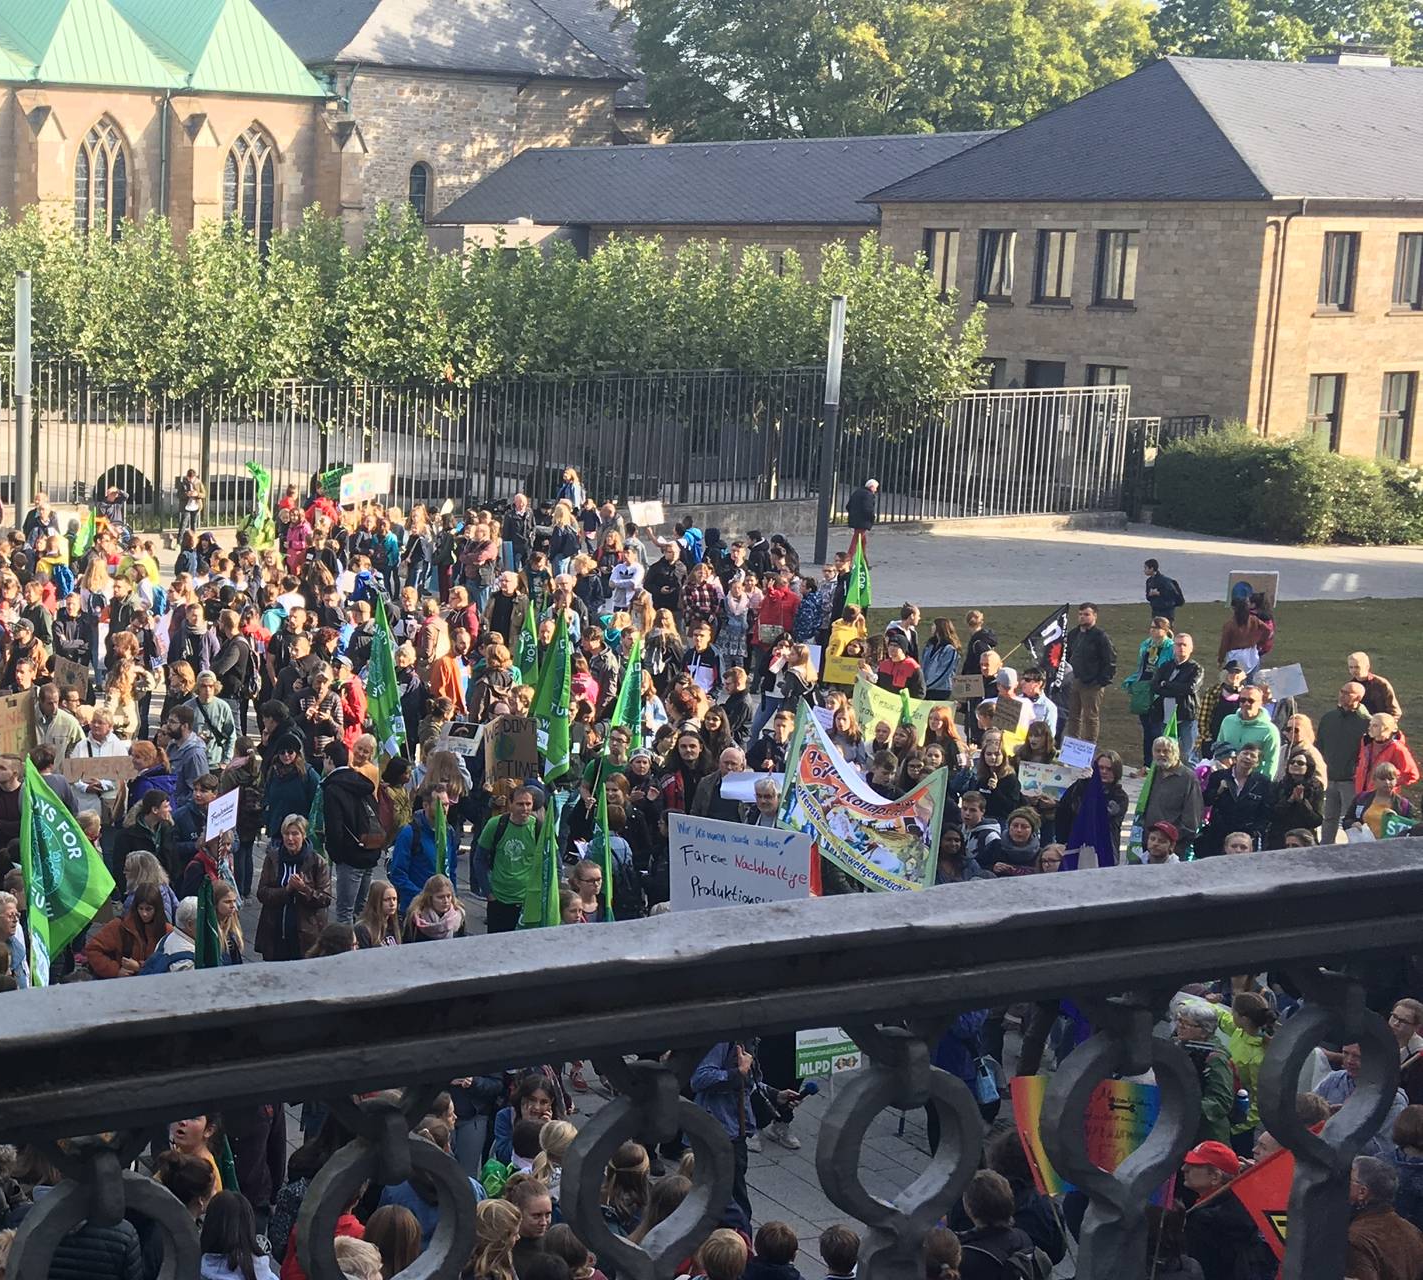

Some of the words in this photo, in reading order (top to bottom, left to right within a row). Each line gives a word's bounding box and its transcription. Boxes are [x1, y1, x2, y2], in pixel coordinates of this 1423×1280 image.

[507, 759, 538, 780] TIME
[56, 821, 82, 860] FOR
[799, 1060, 831, 1077] MLPD
